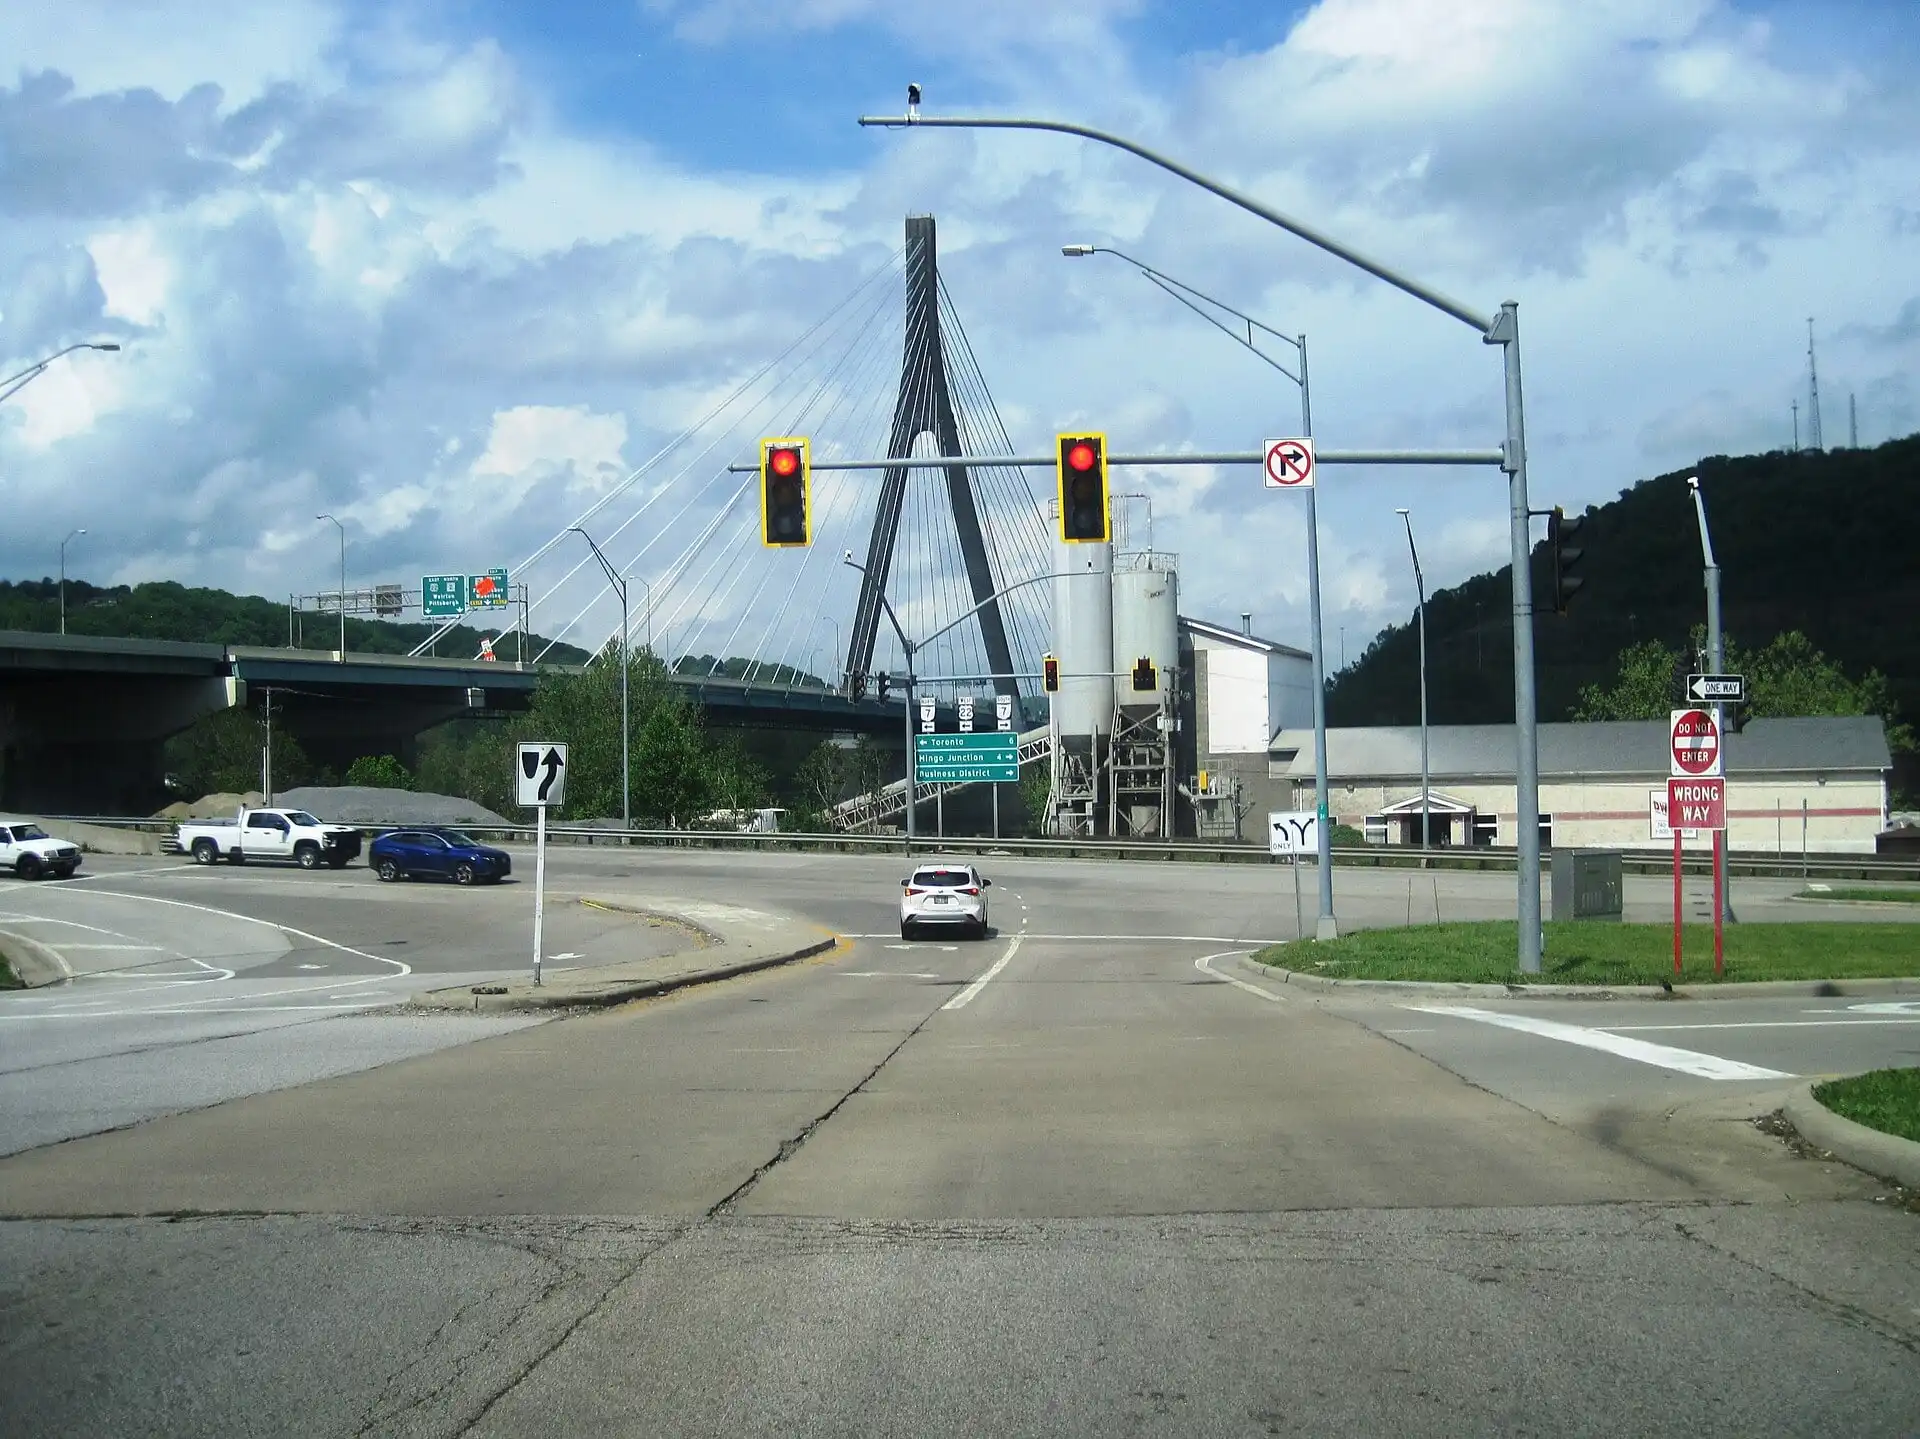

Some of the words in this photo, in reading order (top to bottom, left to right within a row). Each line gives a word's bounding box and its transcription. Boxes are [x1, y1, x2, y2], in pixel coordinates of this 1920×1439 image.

[1705, 683, 1720, 693] ONE
[1723, 683, 1738, 693] WAY
[925, 709, 931, 718] 7
[960, 707, 972, 717] 22
[1001, 706, 1007, 716] 7
[1678, 723, 1690, 734] DO
[1694, 722, 1713, 734] NOT
[931, 738, 964, 746] Toronto
[947, 753, 984, 762] Junction
[1681, 751, 1709, 762] ENTER
[919, 769, 956, 778] Business
[959, 769, 991, 777] District
[1673, 786, 1719, 802] WRONG
[1682, 806, 1710, 822] WAY
[1272, 842, 1291, 850] ONLY
